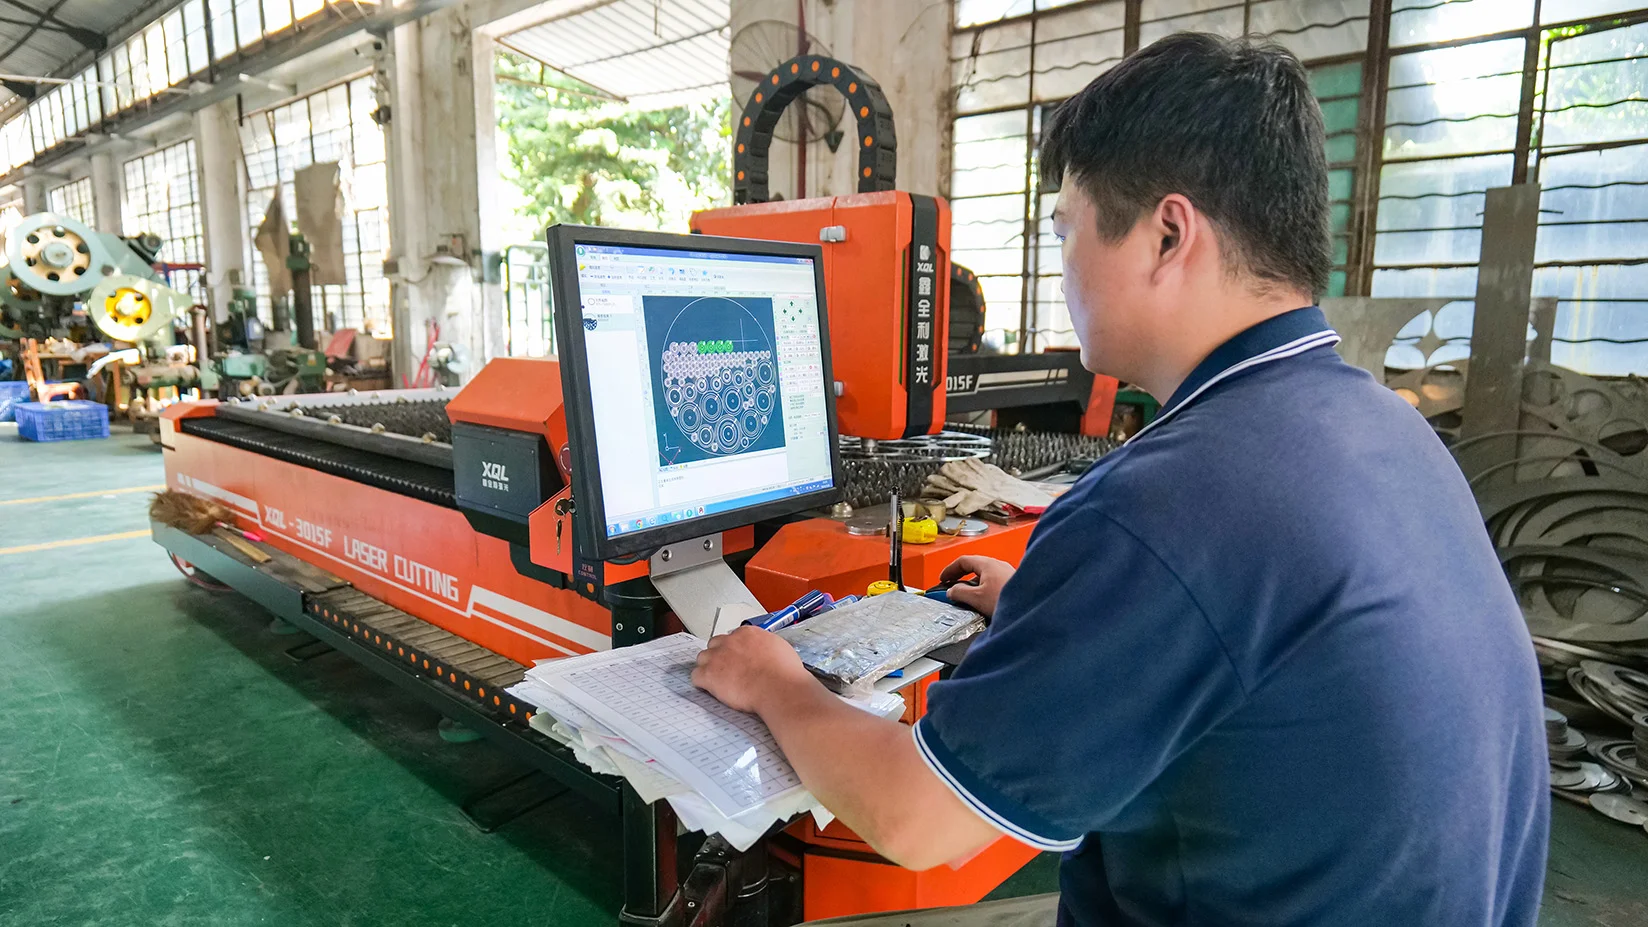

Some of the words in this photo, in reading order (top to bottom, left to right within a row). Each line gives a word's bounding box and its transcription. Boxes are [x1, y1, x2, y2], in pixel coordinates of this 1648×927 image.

[916, 262, 934, 273] XQL
[482, 461, 509, 481] XQL
[264, 504, 287, 530] XQL
[295, 518, 333, 549] 3015F
[343, 535, 388, 573] LASER
[393, 554, 459, 603] CUTTING
